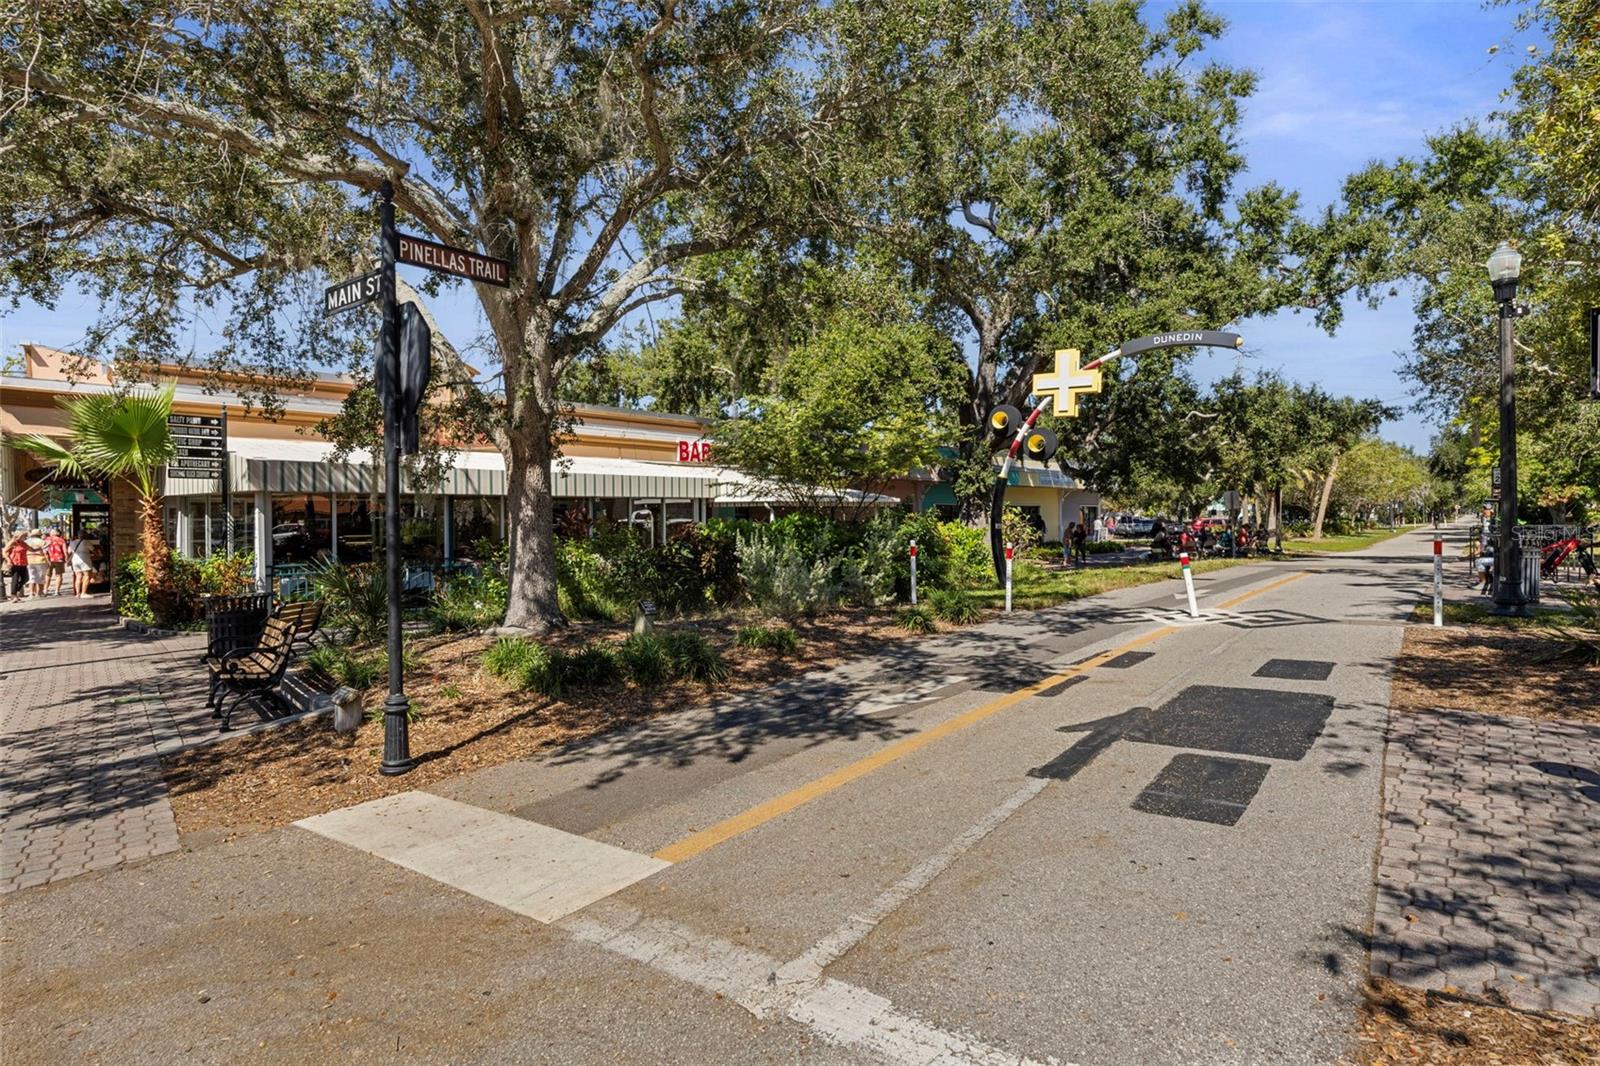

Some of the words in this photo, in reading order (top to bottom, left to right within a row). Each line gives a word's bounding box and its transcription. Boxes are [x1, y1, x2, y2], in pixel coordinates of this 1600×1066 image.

[399, 241, 466, 272] PINELLAS
[469, 257, 504, 282] TRAIL
[328, 282, 362, 310] MAIN
[365, 274, 382, 296] ST
[1153, 333, 1203, 345] DUNEDIN
